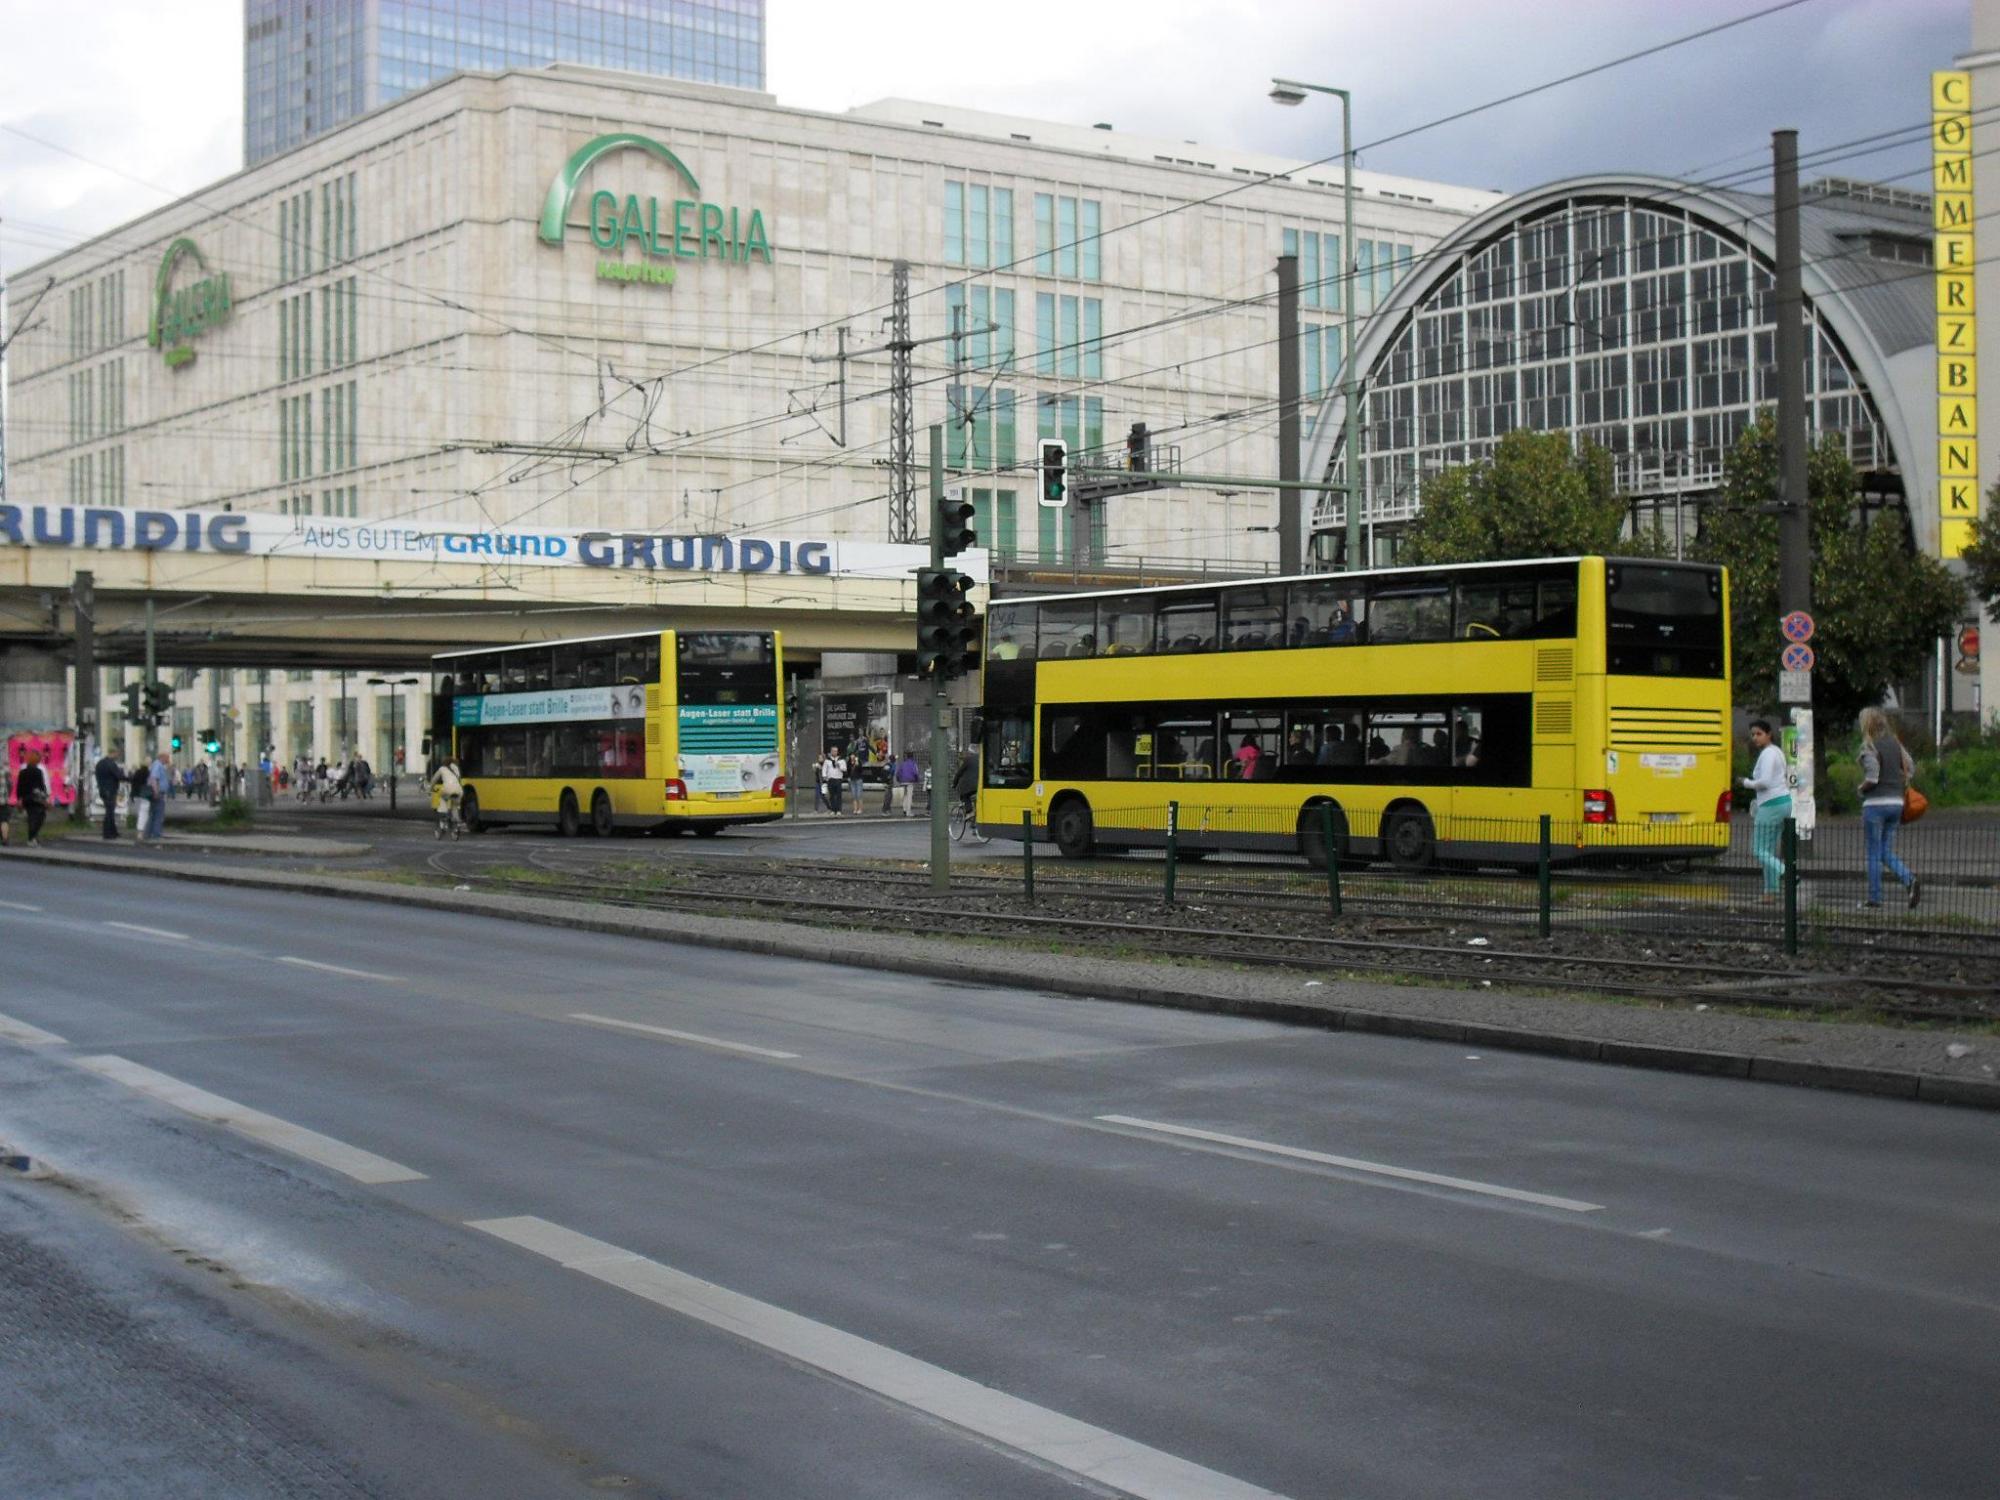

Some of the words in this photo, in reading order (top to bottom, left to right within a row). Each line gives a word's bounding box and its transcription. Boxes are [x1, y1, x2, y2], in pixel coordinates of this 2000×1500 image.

[590, 190, 772, 264] GALERIA
[1940, 79, 1969, 510] COMMERZBANK
[303, 526, 351, 549] AUS
[357, 528, 435, 552] GUTEM
[443, 532, 567, 558] GRUND
[578, 532, 831, 574] GRUNDIG
[484, 700, 527, 721] Augen-Laser
[528, 700, 546, 716] statt
[547, 697, 568, 715] Brille
[680, 708, 731, 719] Augen-Laser
[734, 708, 751, 717] statt
[753, 707, 776, 717] Brille
